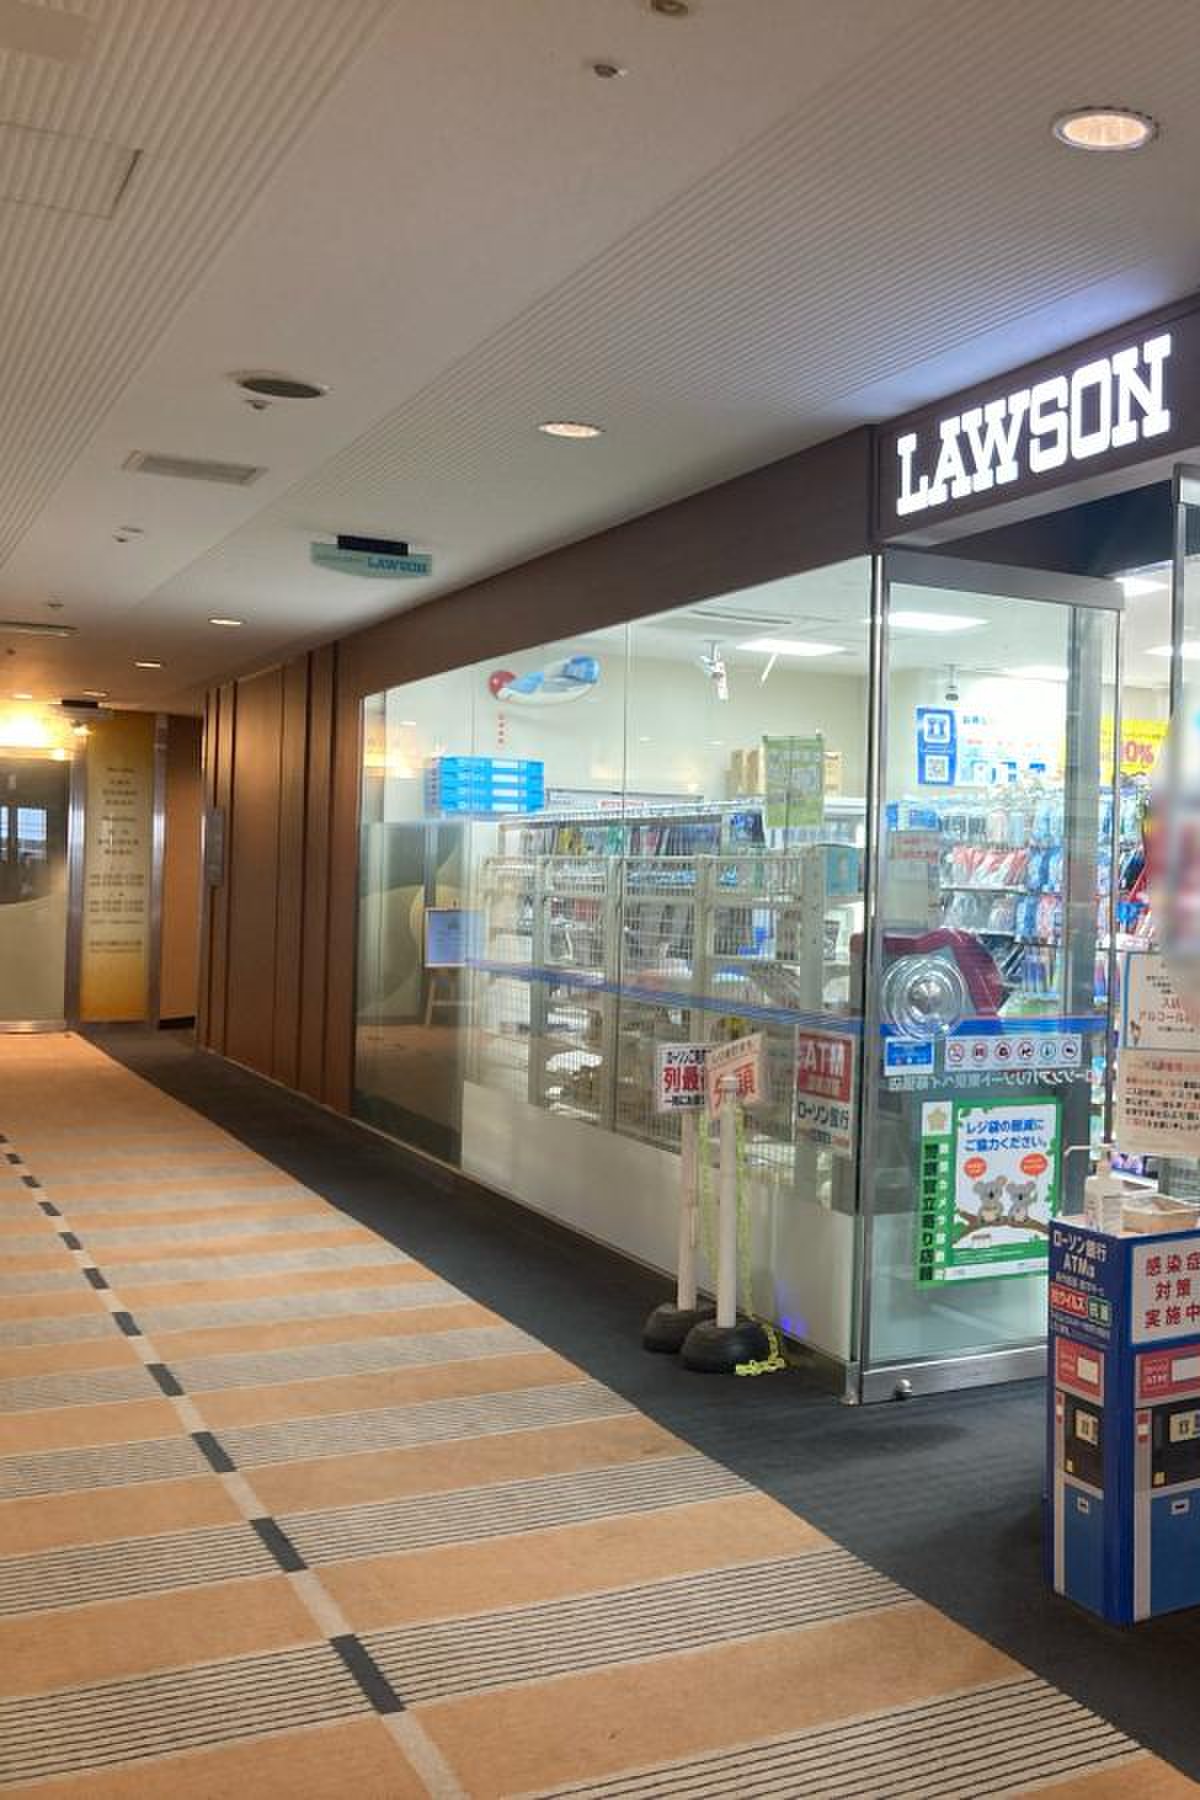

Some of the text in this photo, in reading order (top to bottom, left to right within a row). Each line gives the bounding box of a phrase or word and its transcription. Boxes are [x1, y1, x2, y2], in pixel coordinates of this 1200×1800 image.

[897, 333, 1172, 516] LAWSON
[805, 1041, 844, 1077] ATM
[663, 1065, 705, 1094] 列最
[1053, 1228, 1108, 1263] ローソン銀行
[1155, 1278, 1191, 1301] 対策
